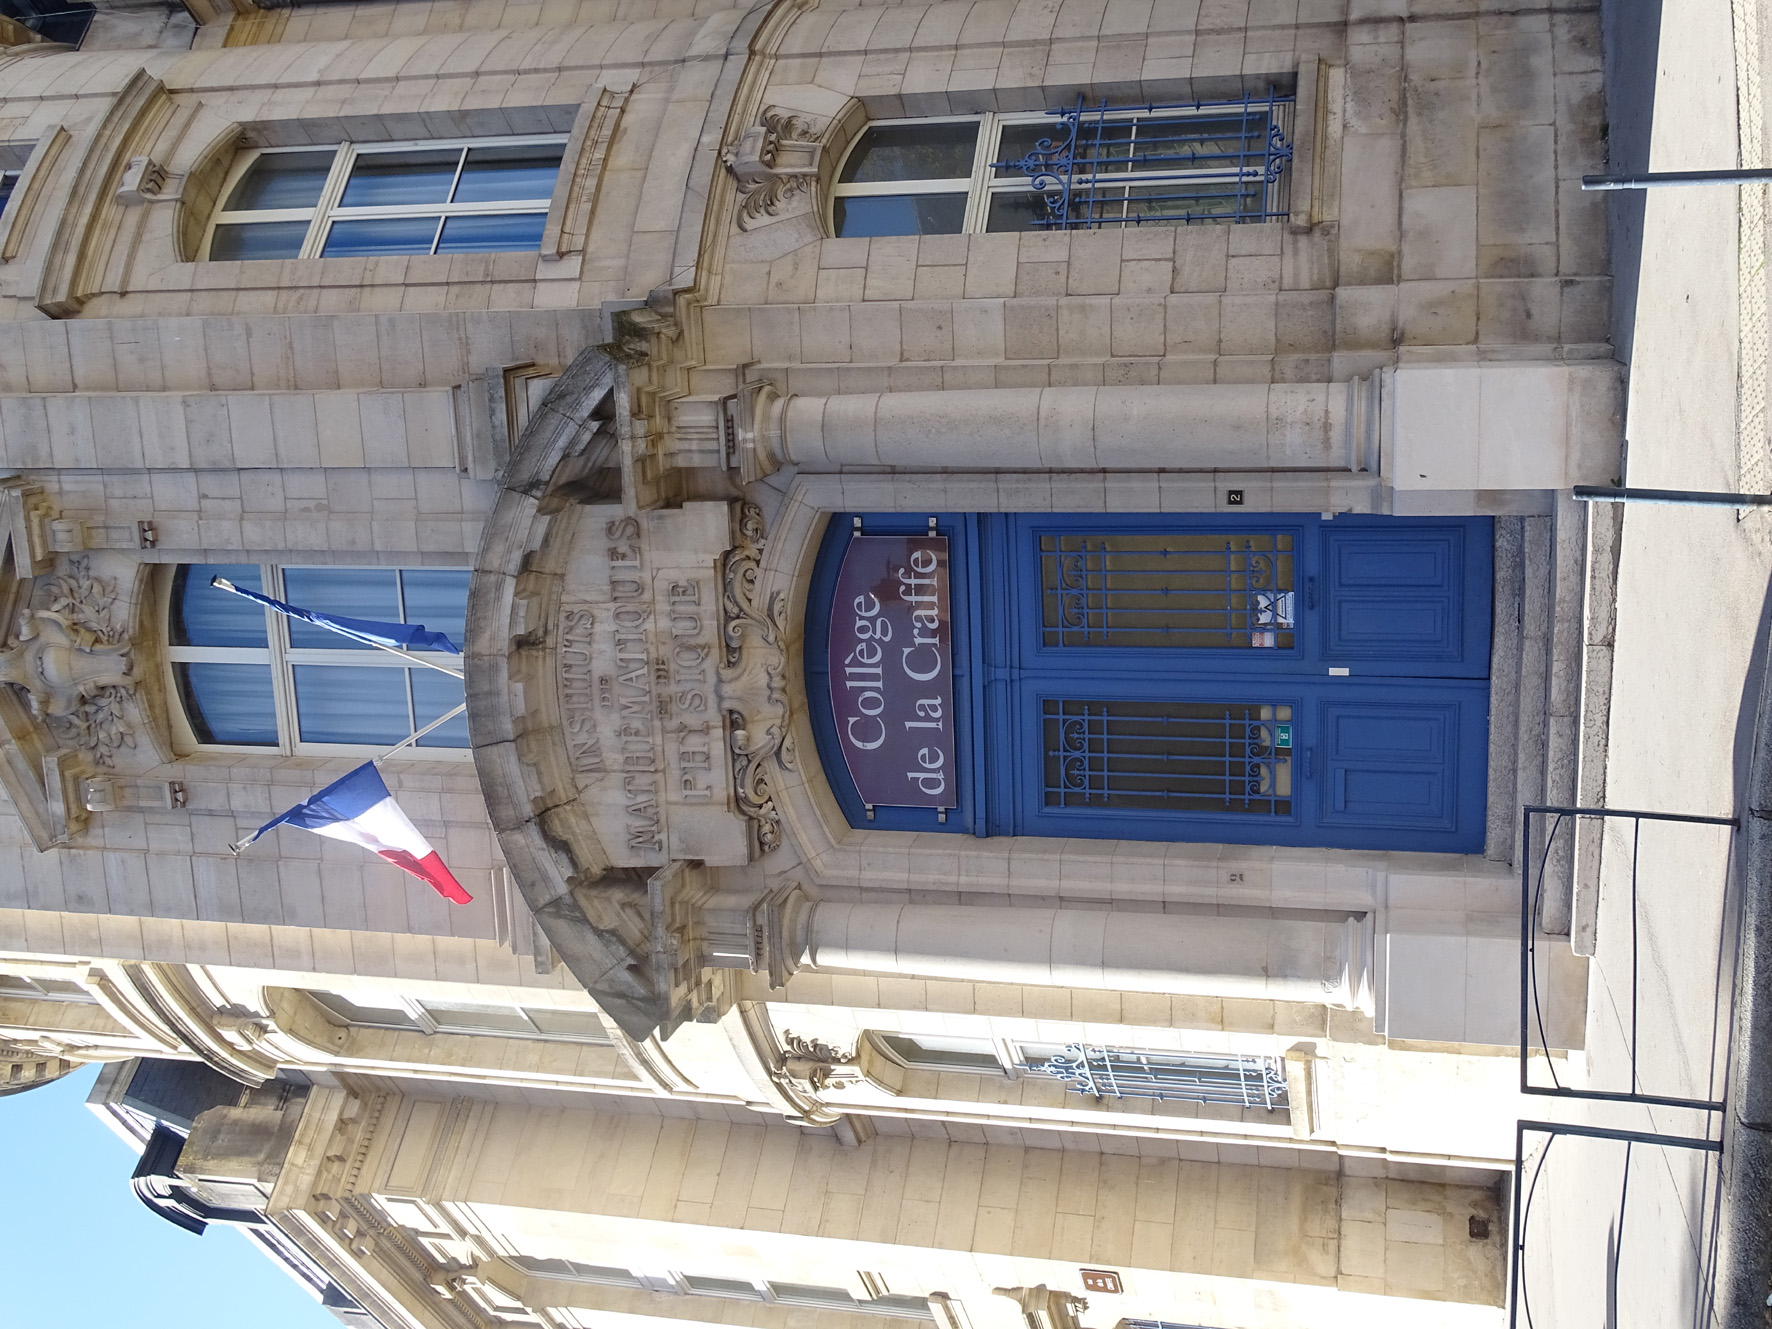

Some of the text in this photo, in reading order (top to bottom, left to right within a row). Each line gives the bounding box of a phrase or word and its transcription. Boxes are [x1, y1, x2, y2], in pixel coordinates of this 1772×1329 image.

[1230, 493, 1240, 502] 2
[562, 610, 605, 773] INSTITUTS
[600, 675, 612, 708] DE
[604, 516, 662, 851] MATHÉMATIQUES
[653, 656, 671, 721] ET DE
[668, 579, 711, 799] PHYSIQUE
[845, 594, 892, 750] Collège
[898, 550, 945, 795] de la Craffe
